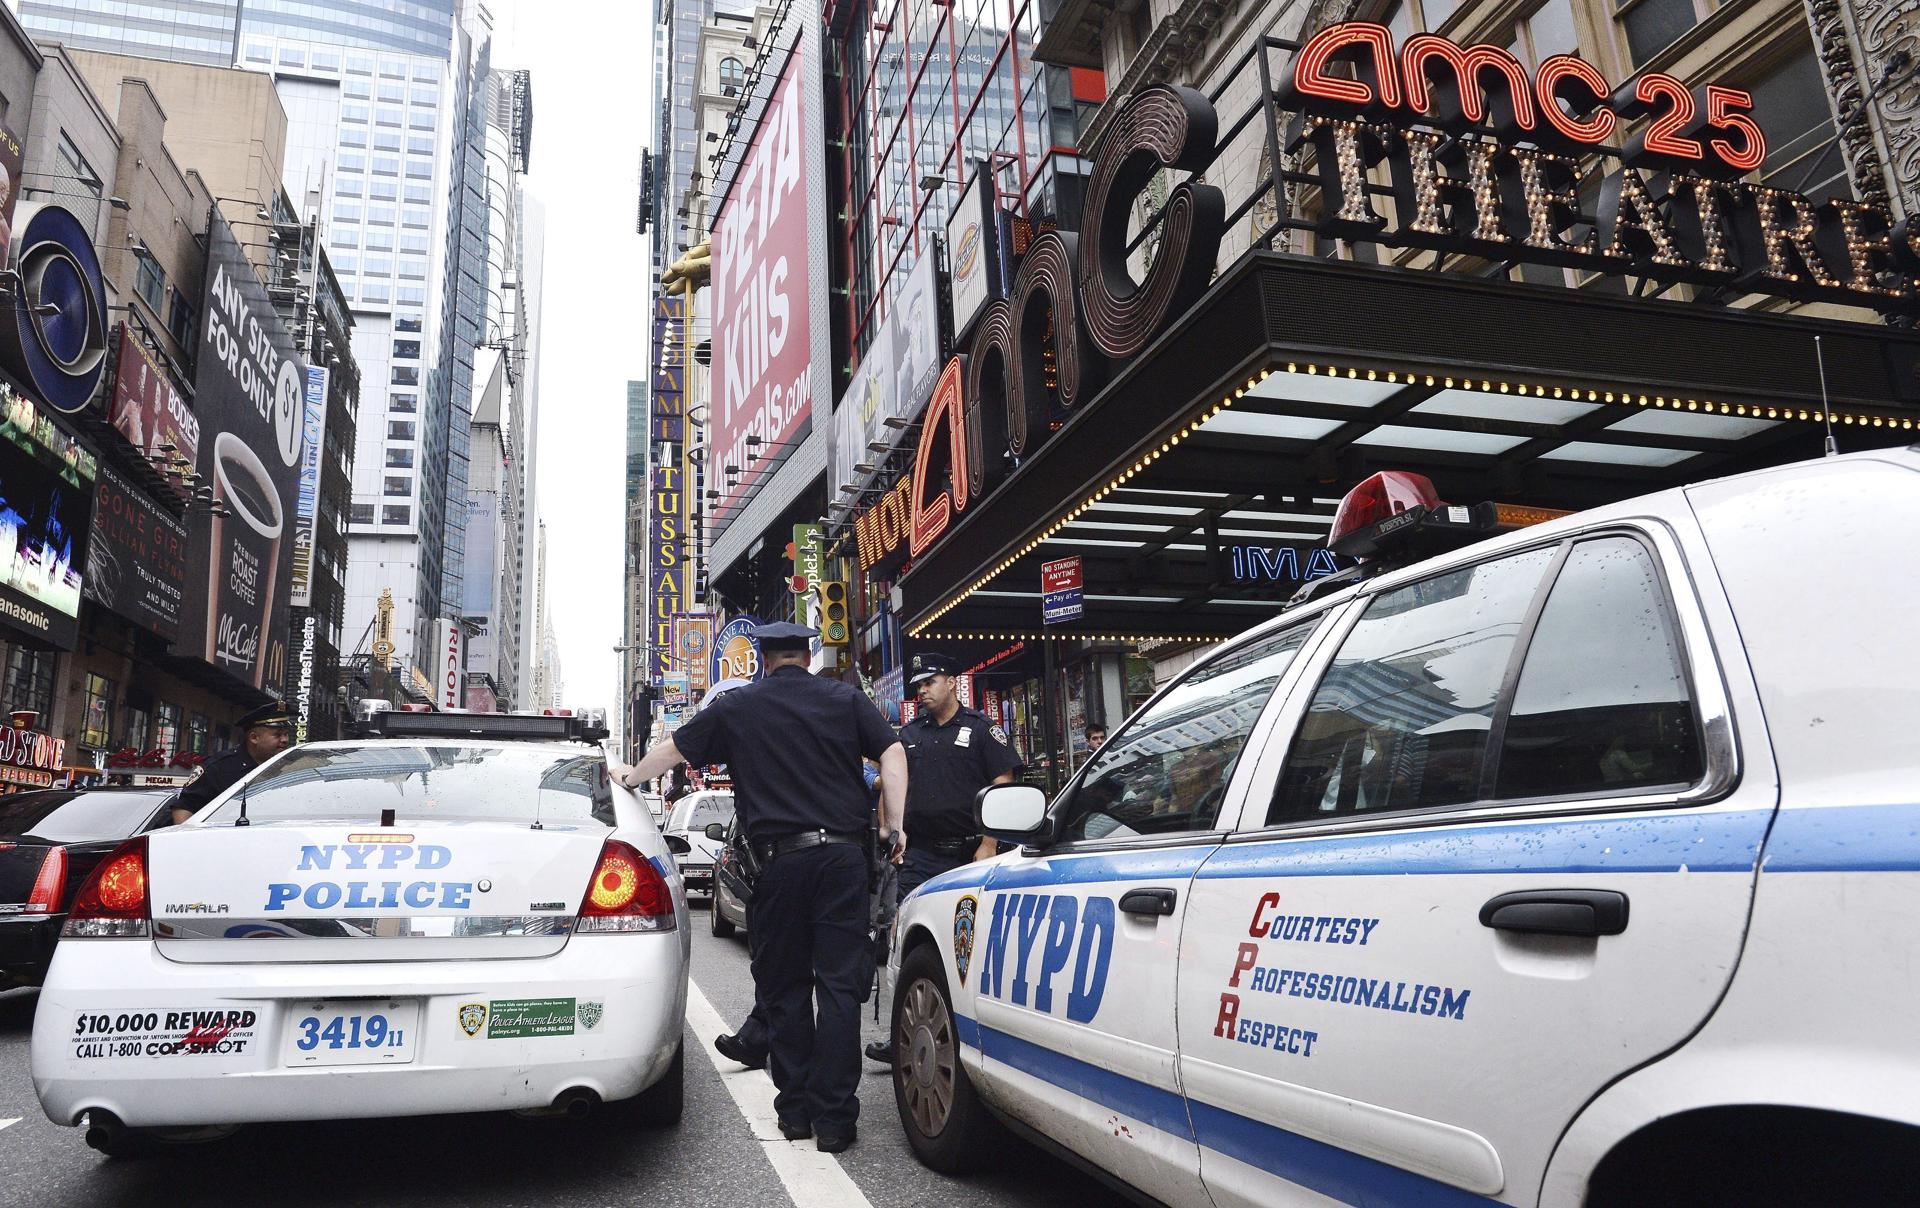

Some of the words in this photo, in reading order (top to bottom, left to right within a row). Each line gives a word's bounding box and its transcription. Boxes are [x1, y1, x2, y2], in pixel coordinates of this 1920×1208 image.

[1635, 72, 1768, 170] 25
[8, 141, 19, 156] US
[718, 68, 800, 327] PETA
[211, 263, 248, 336] ANY
[248, 316, 277, 386] SIZE
[723, 255, 790, 428] Kills
[207, 307, 238, 378] FOR
[240, 357, 274, 423] ONLY
[657, 299, 682, 439] MADAME
[168, 386, 199, 445] BODIES
[283, 375, 298, 454] $1
[100, 484, 146, 534] GONE
[153, 526, 185, 562] GIRL
[234, 538, 259, 567] PREMIUM
[1044, 565, 1052, 573] NO
[1053, 559, 1080, 571] STANDING
[232, 551, 258, 587] ROAST
[657, 468, 680, 673] TUSSAUDS
[1048, 569, 1075, 580] ANYTIME
[146, 591, 159, 604] AND
[157, 579, 181, 600] TWISTED
[230, 573, 257, 606] COFFEE
[1053, 594, 1065, 603] Pay
[1046, 606, 1081, 618] Muni-Meter
[717, 624, 737, 652] DAVE
[447, 627, 459, 708] RICOH
[664, 686, 680, 694] New
[664, 694, 686, 704] Victory
[16, 730, 65, 770] STONE
[145, 776, 173, 785] MEGAN
[297, 844, 452, 870] NYPD
[165, 903, 230, 914] IMPALA
[264, 881, 473, 911] POLICE
[1249, 892, 1379, 946] COURTESY
[980, 893, 1115, 1024] NYPD
[1228, 942, 1471, 1020] PROFESSIONALISM
[75, 1012, 158, 1035] $10,000
[164, 1010, 257, 1031] REWARD
[297, 1015, 389, 1051] 3419
[388, 1030, 403, 1048] 11
[491, 1028, 521, 1036] palnyc.org
[513, 1013, 546, 1026] ATHLETIC
[546, 1012, 574, 1025] LEAGUE
[1213, 992, 1318, 1057] RESPECT
[76, 1044, 104, 1058] CALL
[108, 1042, 142, 1057] 1-800
[145, 1038, 247, 1056] COP-SHOT
